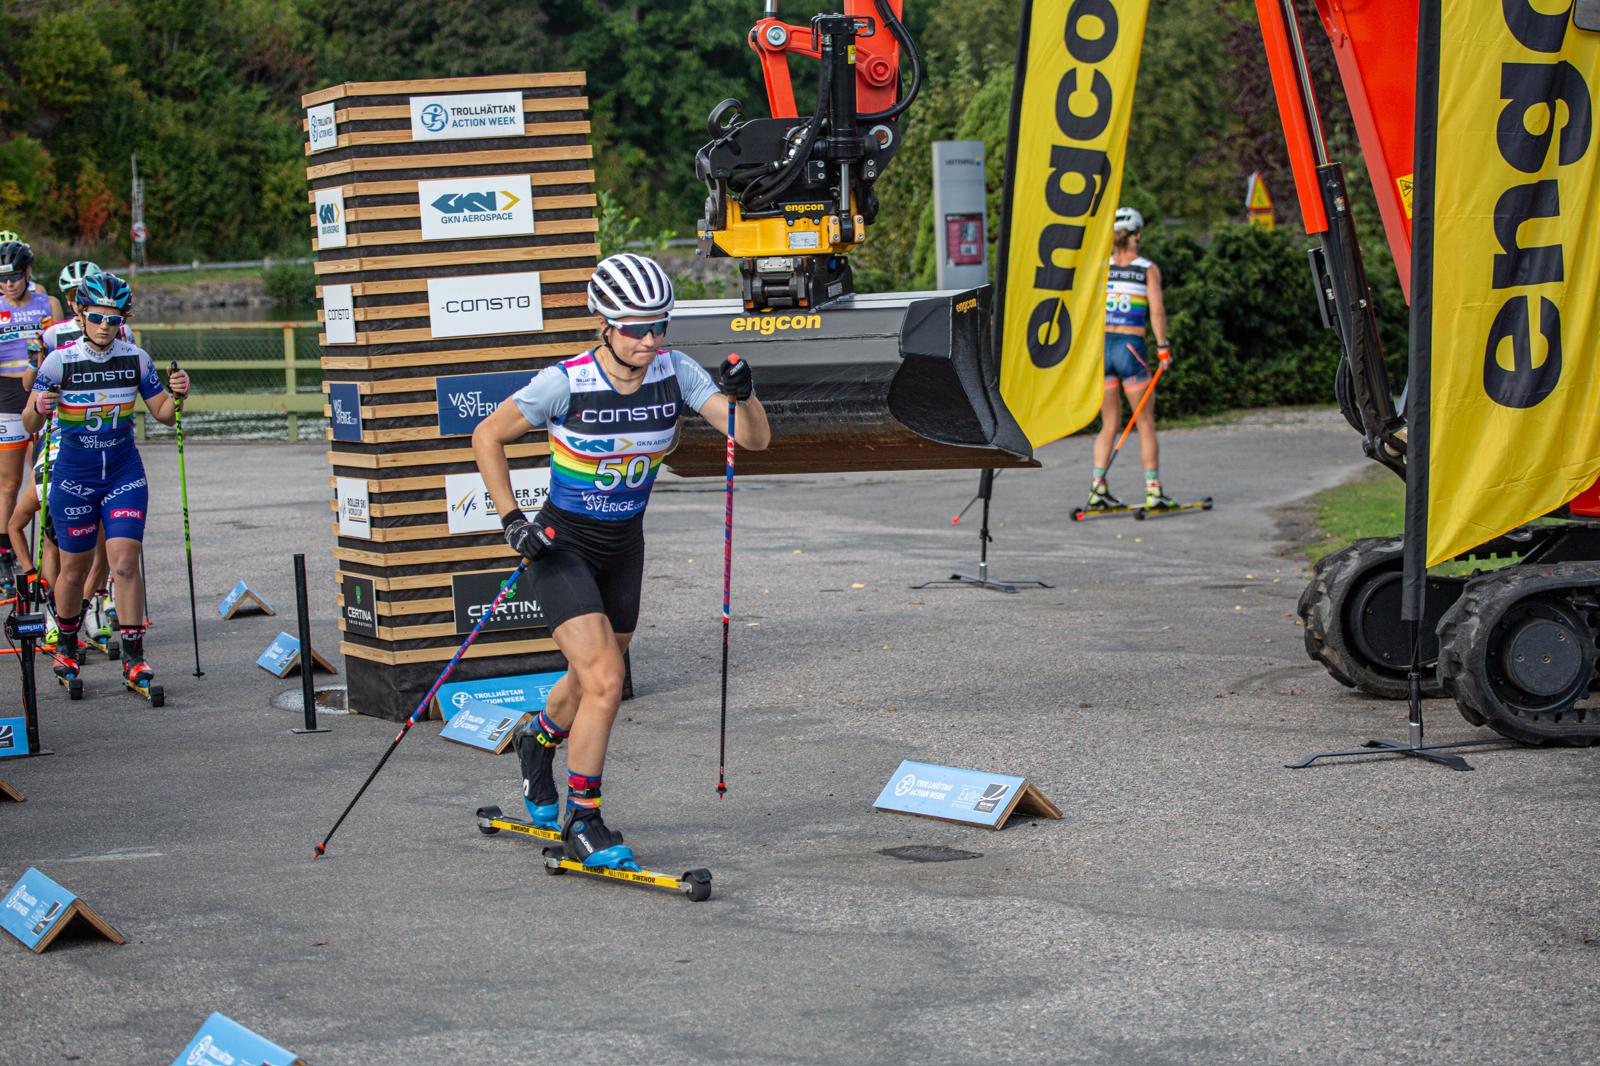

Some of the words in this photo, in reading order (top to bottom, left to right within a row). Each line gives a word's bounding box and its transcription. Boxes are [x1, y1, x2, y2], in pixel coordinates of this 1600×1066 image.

[451, 104, 516, 117] TROLLHÄTTAN
[452, 118, 486, 128] ACTION
[488, 116, 516, 125] WEEK
[785, 203, 825, 213] engcon
[441, 215, 460, 224] GKN
[462, 212, 513, 223] AEROSPACE
[956, 298, 977, 313] engcon
[1106, 293, 1131, 313] 58
[731, 314, 821, 335] engcon
[71, 369, 136, 384] CONSTO
[85, 405, 120, 432] 51
[582, 403, 676, 423] CONSTO
[594, 455, 652, 491] 50
[60, 479, 95, 497] EA7
[521, 499, 538, 507] CUP
[114, 510, 140, 518] enel
[72, 524, 96, 536] enel
[348, 606, 372, 621] CERTINA
[467, 600, 541, 617] CERTIN
[474, 688, 524, 699] TROLLHÄTTAN
[632, 874, 656, 883] SWENOR
